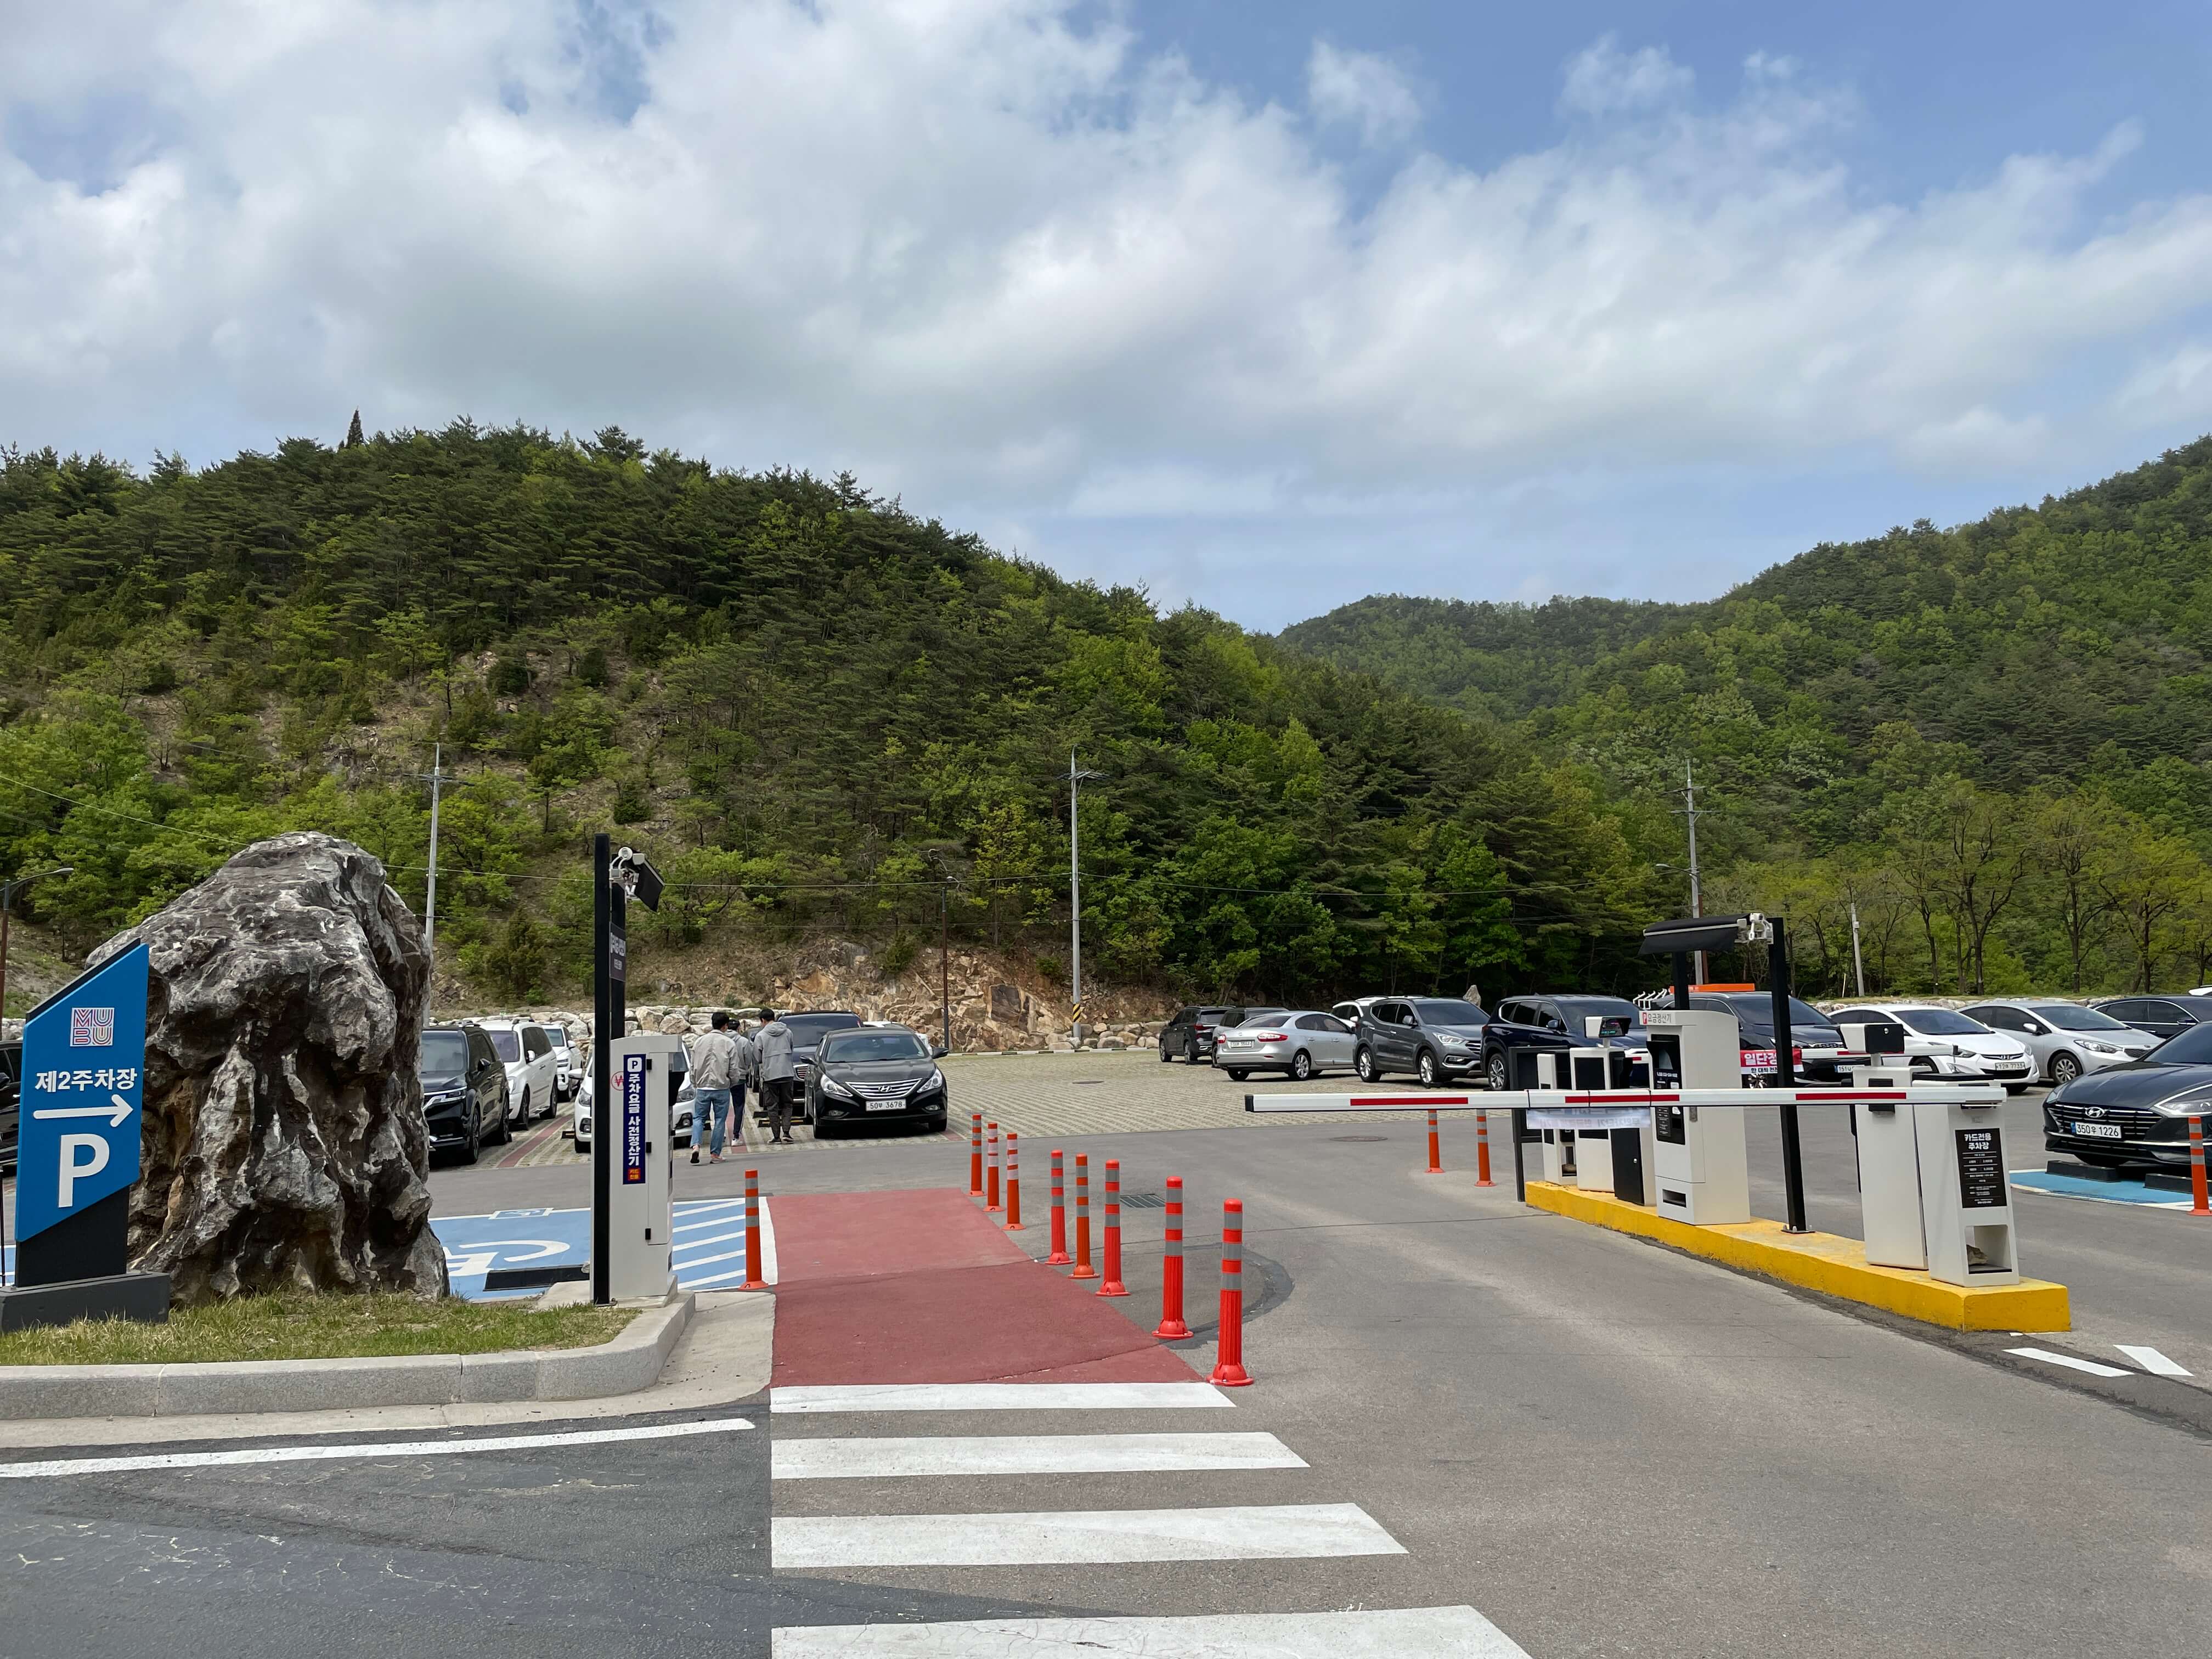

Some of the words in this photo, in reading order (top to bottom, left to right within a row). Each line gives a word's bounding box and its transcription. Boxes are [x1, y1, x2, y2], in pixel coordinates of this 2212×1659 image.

[1648, 1013, 1672, 1024] 요금정산기
[1744, 1053, 1777, 1065] 일단정
[35, 1068, 137, 1093] 제2주차장
[628, 1074, 641, 1114] 주차요금
[2076, 1124, 2097, 1135] 350우
[2098, 1126, 2119, 1137] 1226
[628, 1116, 641, 1166] 사전정산기
[1964, 1133, 1991, 1142] 카드전용
[1968, 1142, 1990, 1150] 주차장
[58, 1133, 110, 1207] P
